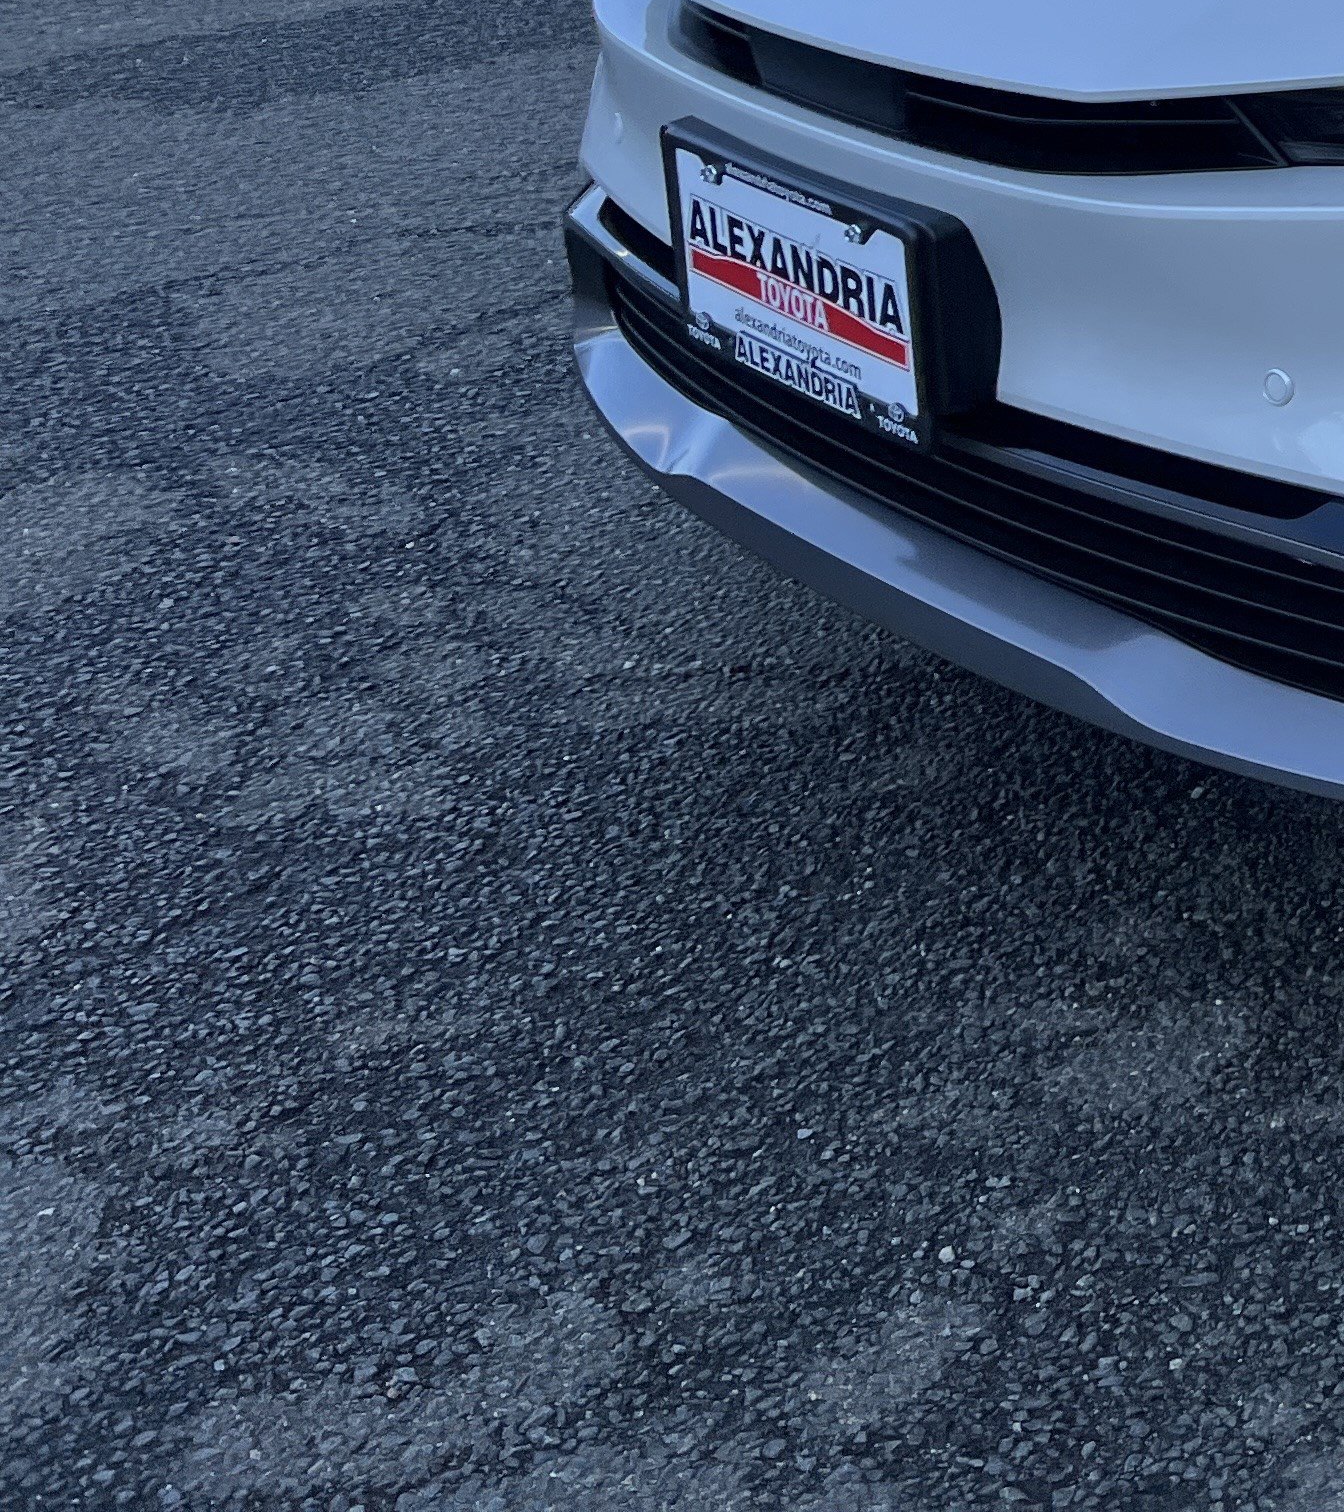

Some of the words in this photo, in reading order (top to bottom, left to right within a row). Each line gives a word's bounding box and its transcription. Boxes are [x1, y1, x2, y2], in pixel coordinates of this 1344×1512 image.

[689, 199, 905, 335] ALEXANDRIA
[686, 323, 722, 350] TOYOTA
[756, 272, 831, 333] TOYOTA
[735, 306, 862, 381] alexandriatoyota.com
[735, 333, 862, 419] ALEXANDRIA
[876, 415, 919, 445] TOYOTA
